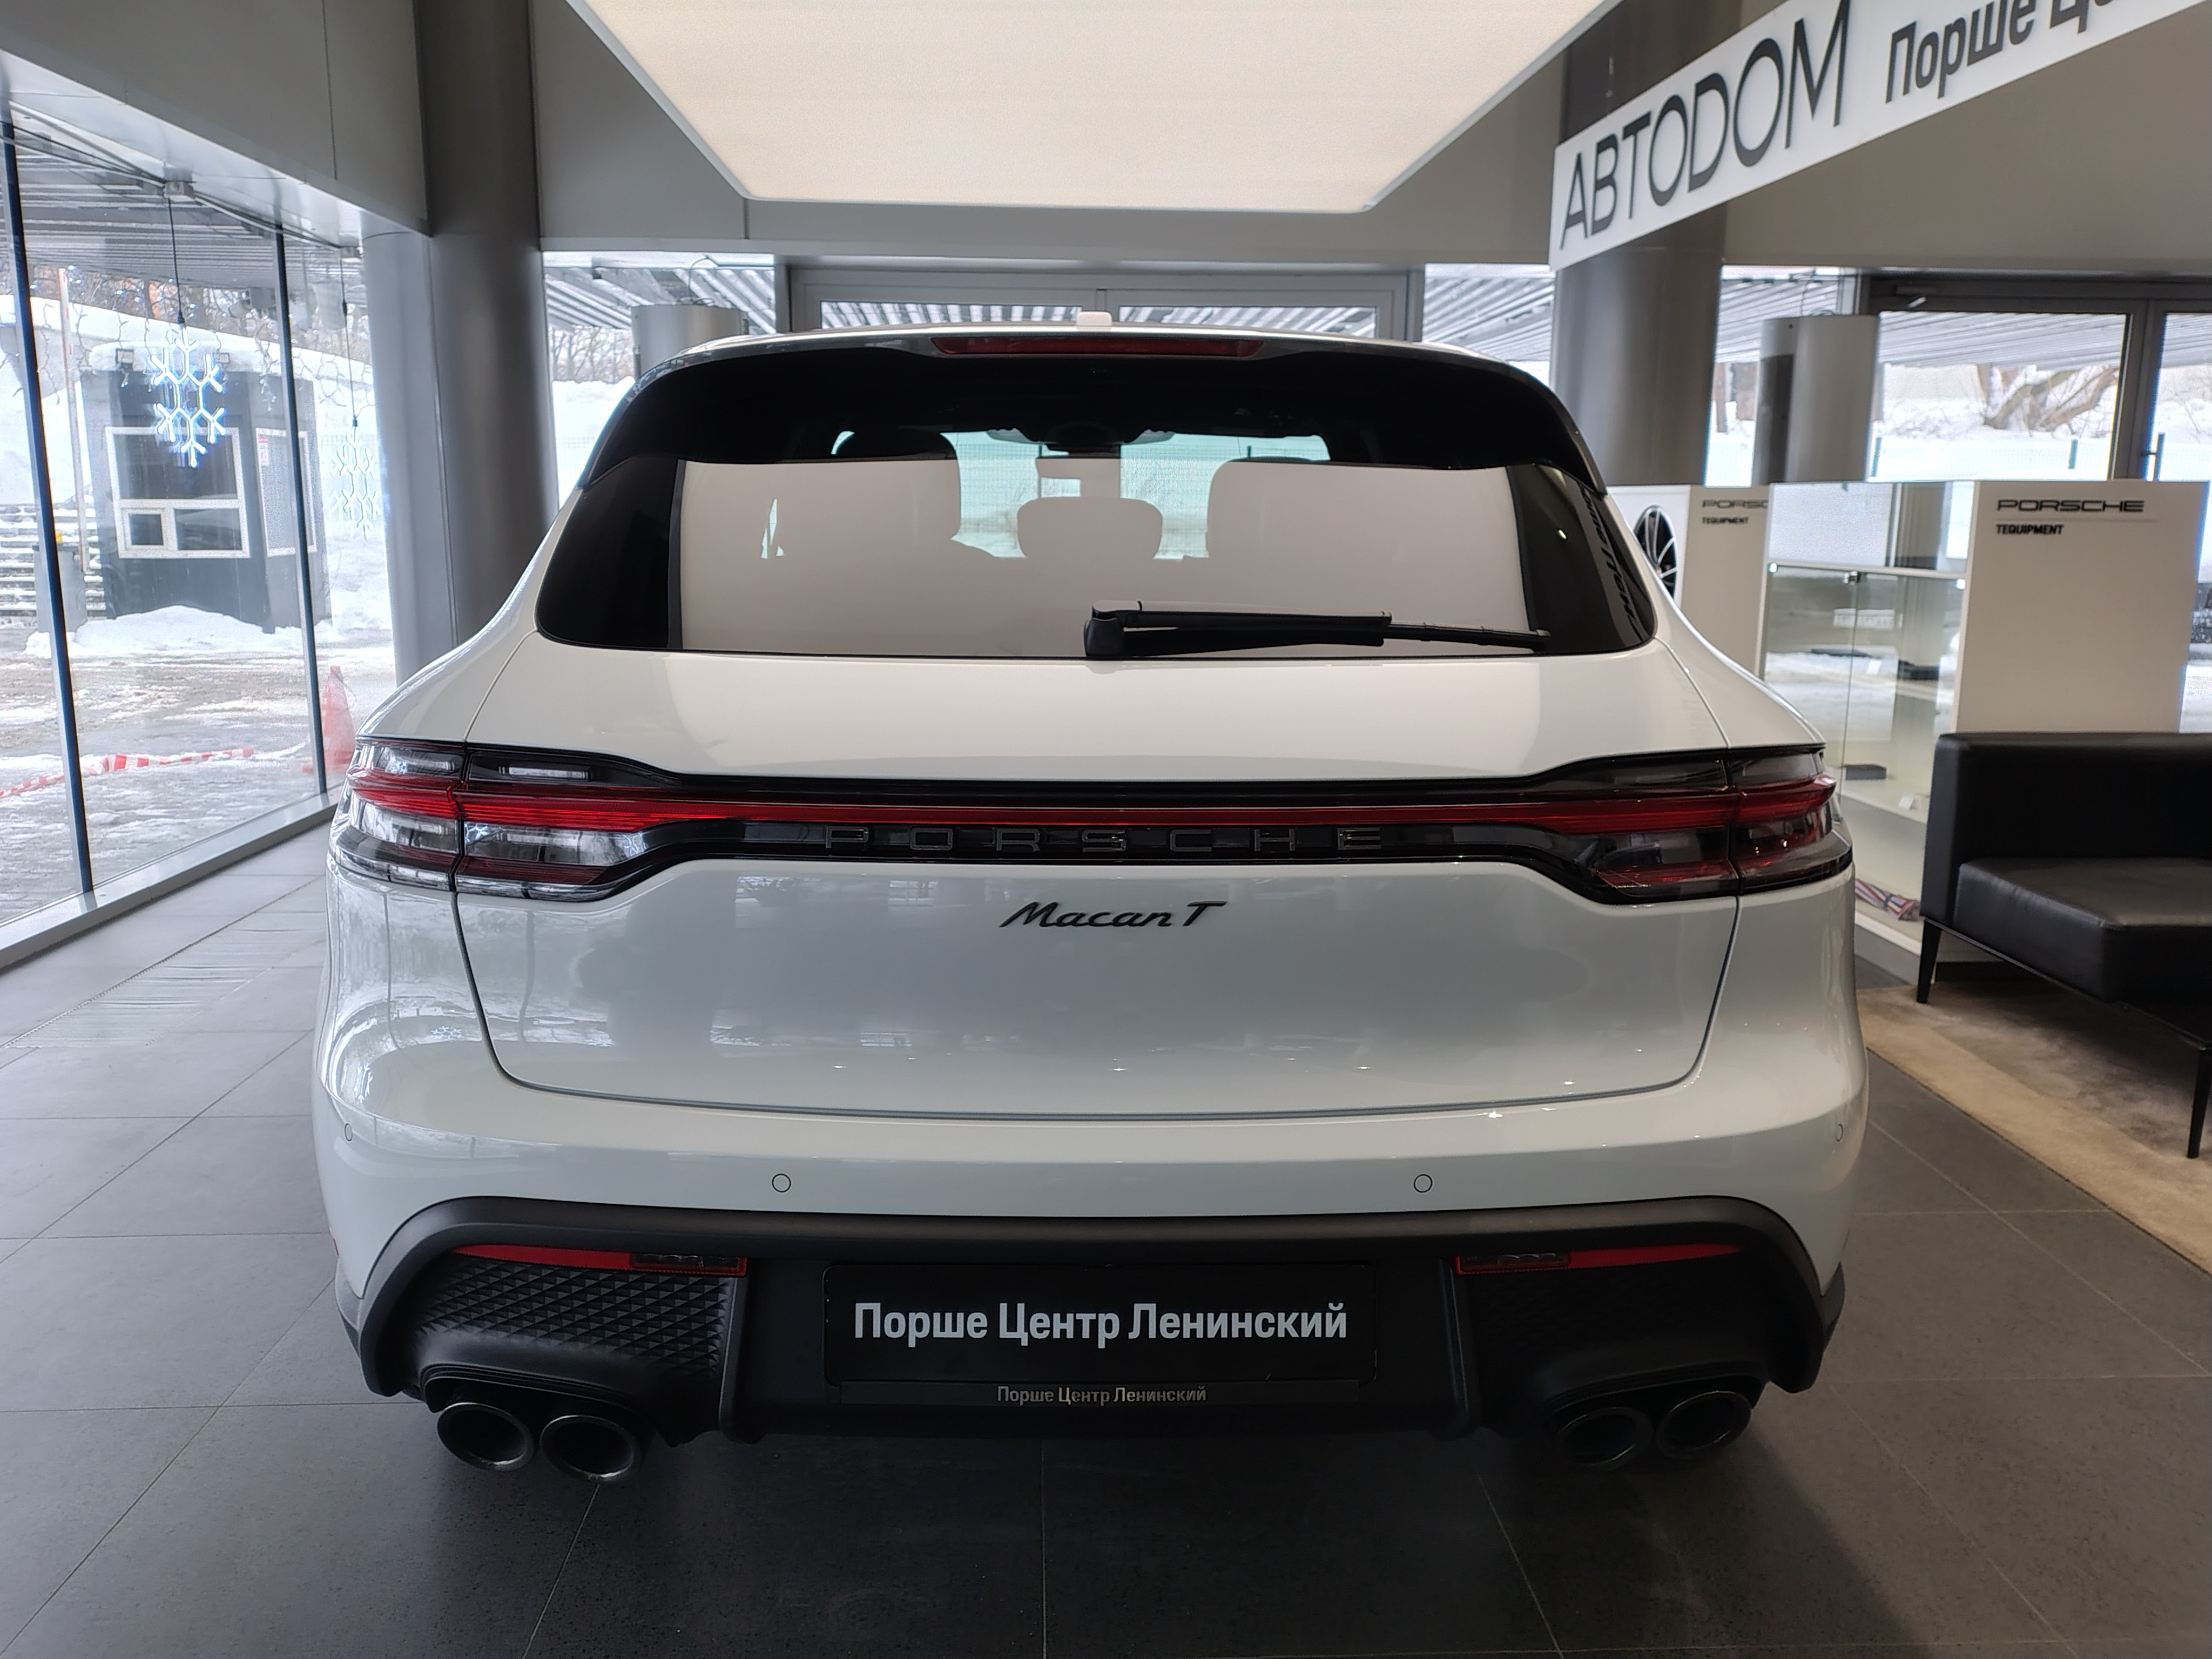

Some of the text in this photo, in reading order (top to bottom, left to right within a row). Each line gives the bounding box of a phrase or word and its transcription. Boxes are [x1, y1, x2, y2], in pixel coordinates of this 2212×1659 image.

[1885, 0, 2036, 104] Порше
[1997, 500, 2144, 512] PORSCHE
[1996, 524, 2064, 535] TEQUIPMENT
[826, 826, 1381, 853] PORSCHE
[855, 1302, 1346, 1349] Порше Центр Ленинский
[997, 1386, 1206, 1406] Порше Центр Ленинский
